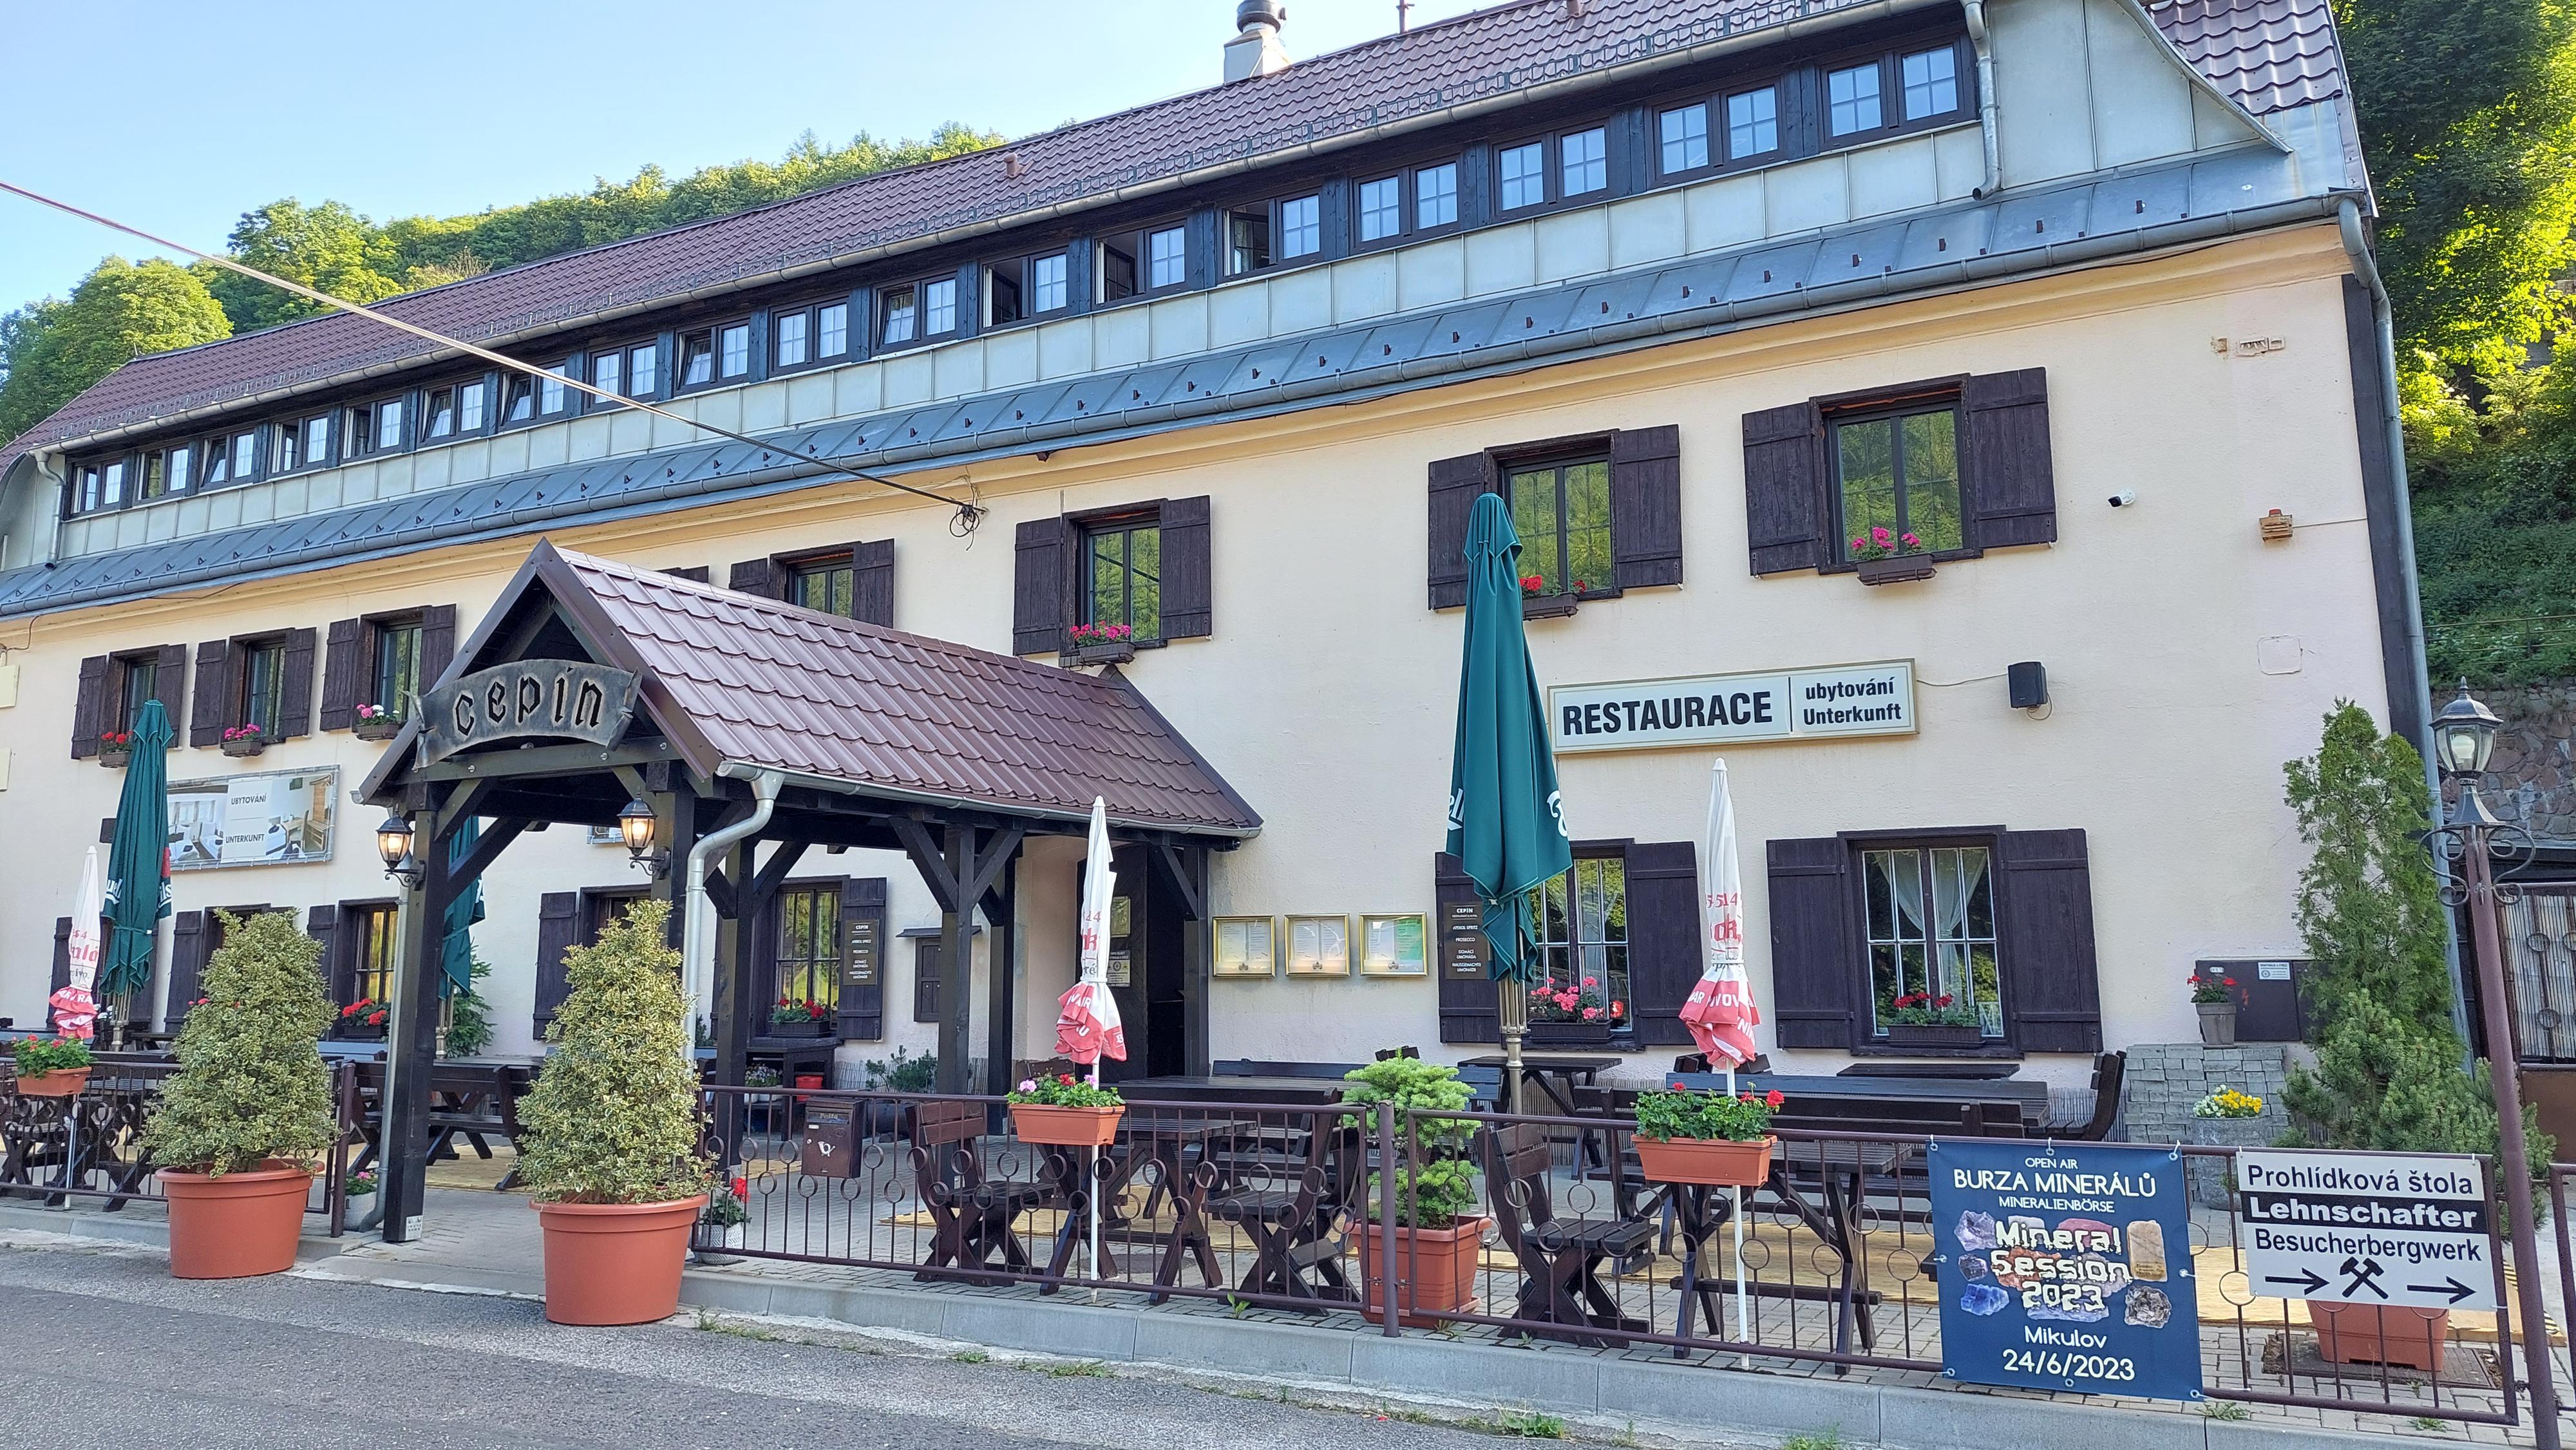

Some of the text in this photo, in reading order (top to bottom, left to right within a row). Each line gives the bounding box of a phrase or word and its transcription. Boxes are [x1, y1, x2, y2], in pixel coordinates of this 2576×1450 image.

[1805, 677, 1895, 701] ubytování
[1563, 691, 1773, 736] RESTAURACE
[1803, 703, 1902, 725] Unterkunft
[231, 793, 267, 805] UBYTOVÁNÍ
[225, 834, 265, 843] UNTERKUNFT
[2025, 1157, 2079, 1169] OPEN AIR
[1953, 1169, 2156, 1198] BURZA MINERÁLŮ
[2247, 1164, 2474, 1194] Prohlídková štola
[1998, 1195, 2116, 1214] MINERALIENBÖRSE
[2249, 1196, 2477, 1229] Lehnschafter
[1996, 1220, 2122, 1254] Mineral
[2255, 1227, 2483, 1265] Besucherbergwerk
[1990, 1250, 2134, 1285] Session
[2022, 1281, 2105, 1312] 2023
[2024, 1325, 2108, 1349] Mikulov
[2002, 1349, 2136, 1381] 24/6/2023
